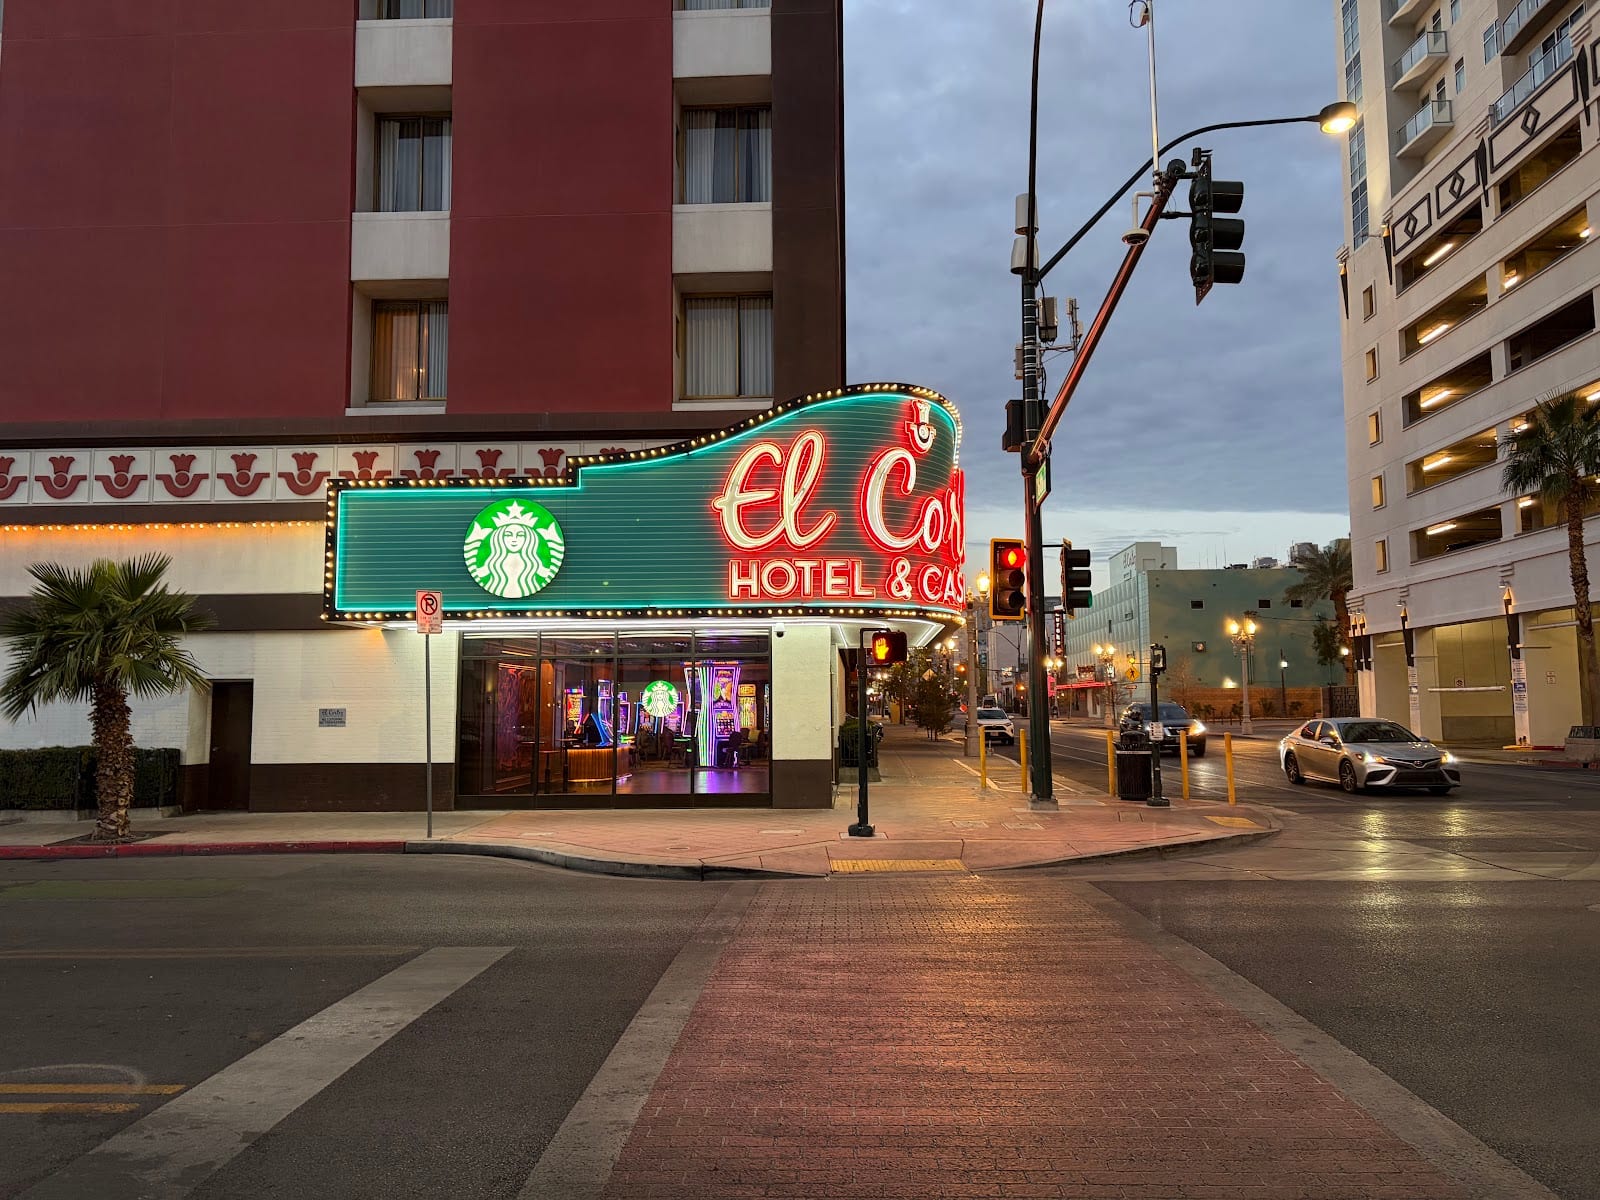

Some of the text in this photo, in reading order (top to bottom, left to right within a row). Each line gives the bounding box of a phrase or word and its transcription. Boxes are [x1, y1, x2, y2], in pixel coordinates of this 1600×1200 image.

[712, 430, 836, 552] El
[729, 556, 966, 608] HOTEL & CAS
